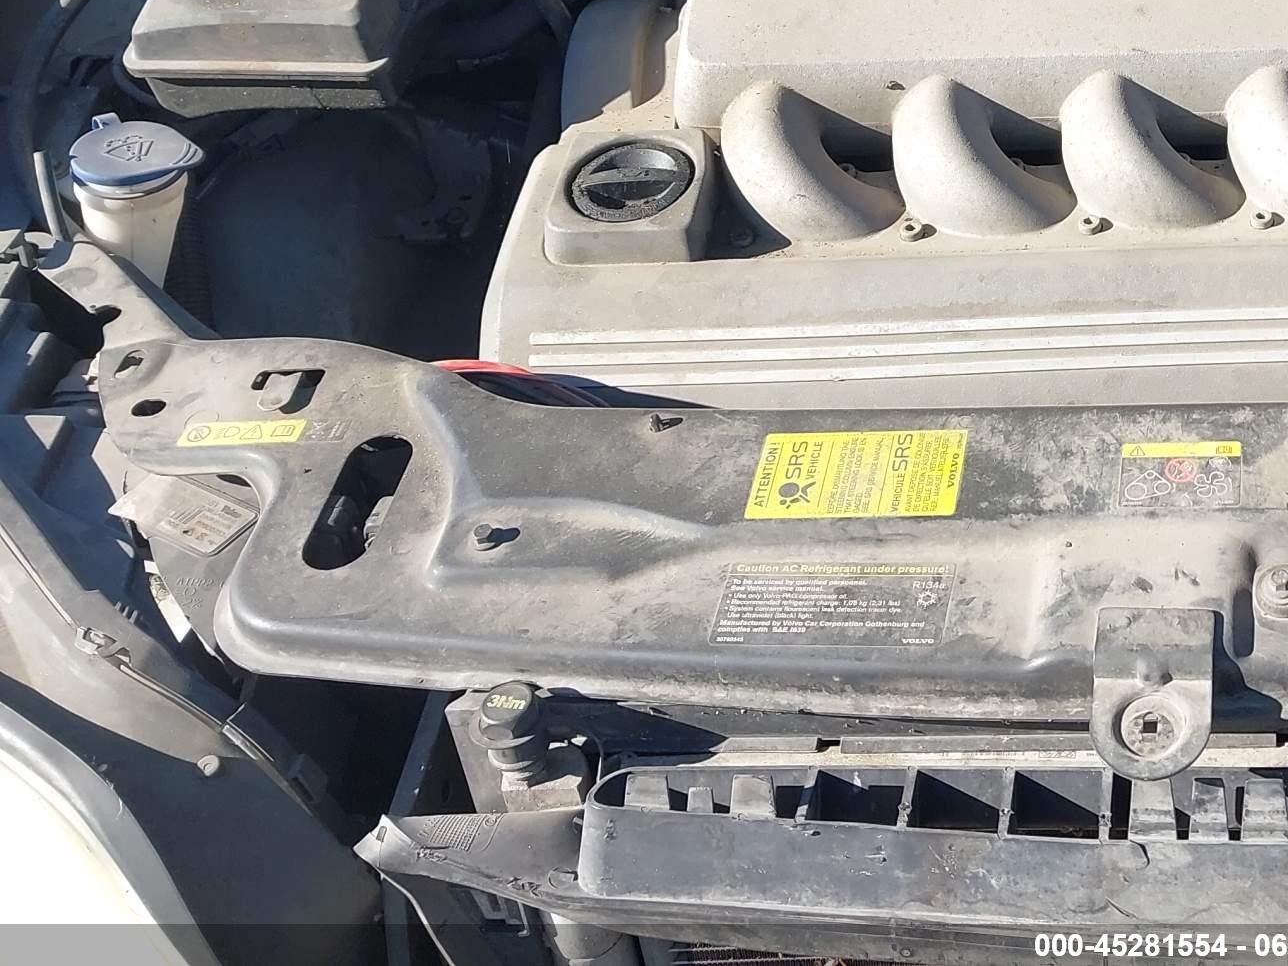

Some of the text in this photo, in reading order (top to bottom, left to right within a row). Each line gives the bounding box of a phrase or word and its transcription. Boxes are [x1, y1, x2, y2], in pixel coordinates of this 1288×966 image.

[785, 441, 808, 480] SRS
[805, 441, 823, 480] VEHICLE
[890, 433, 913, 512] VEHICULE SRS
[947, 452, 959, 487] VOLVO
[737, 564, 949, 575] Caution AC Refrigerant under pressure!
[912, 580, 945, 589] R134a
[486, 694, 526, 710] 3Nm
